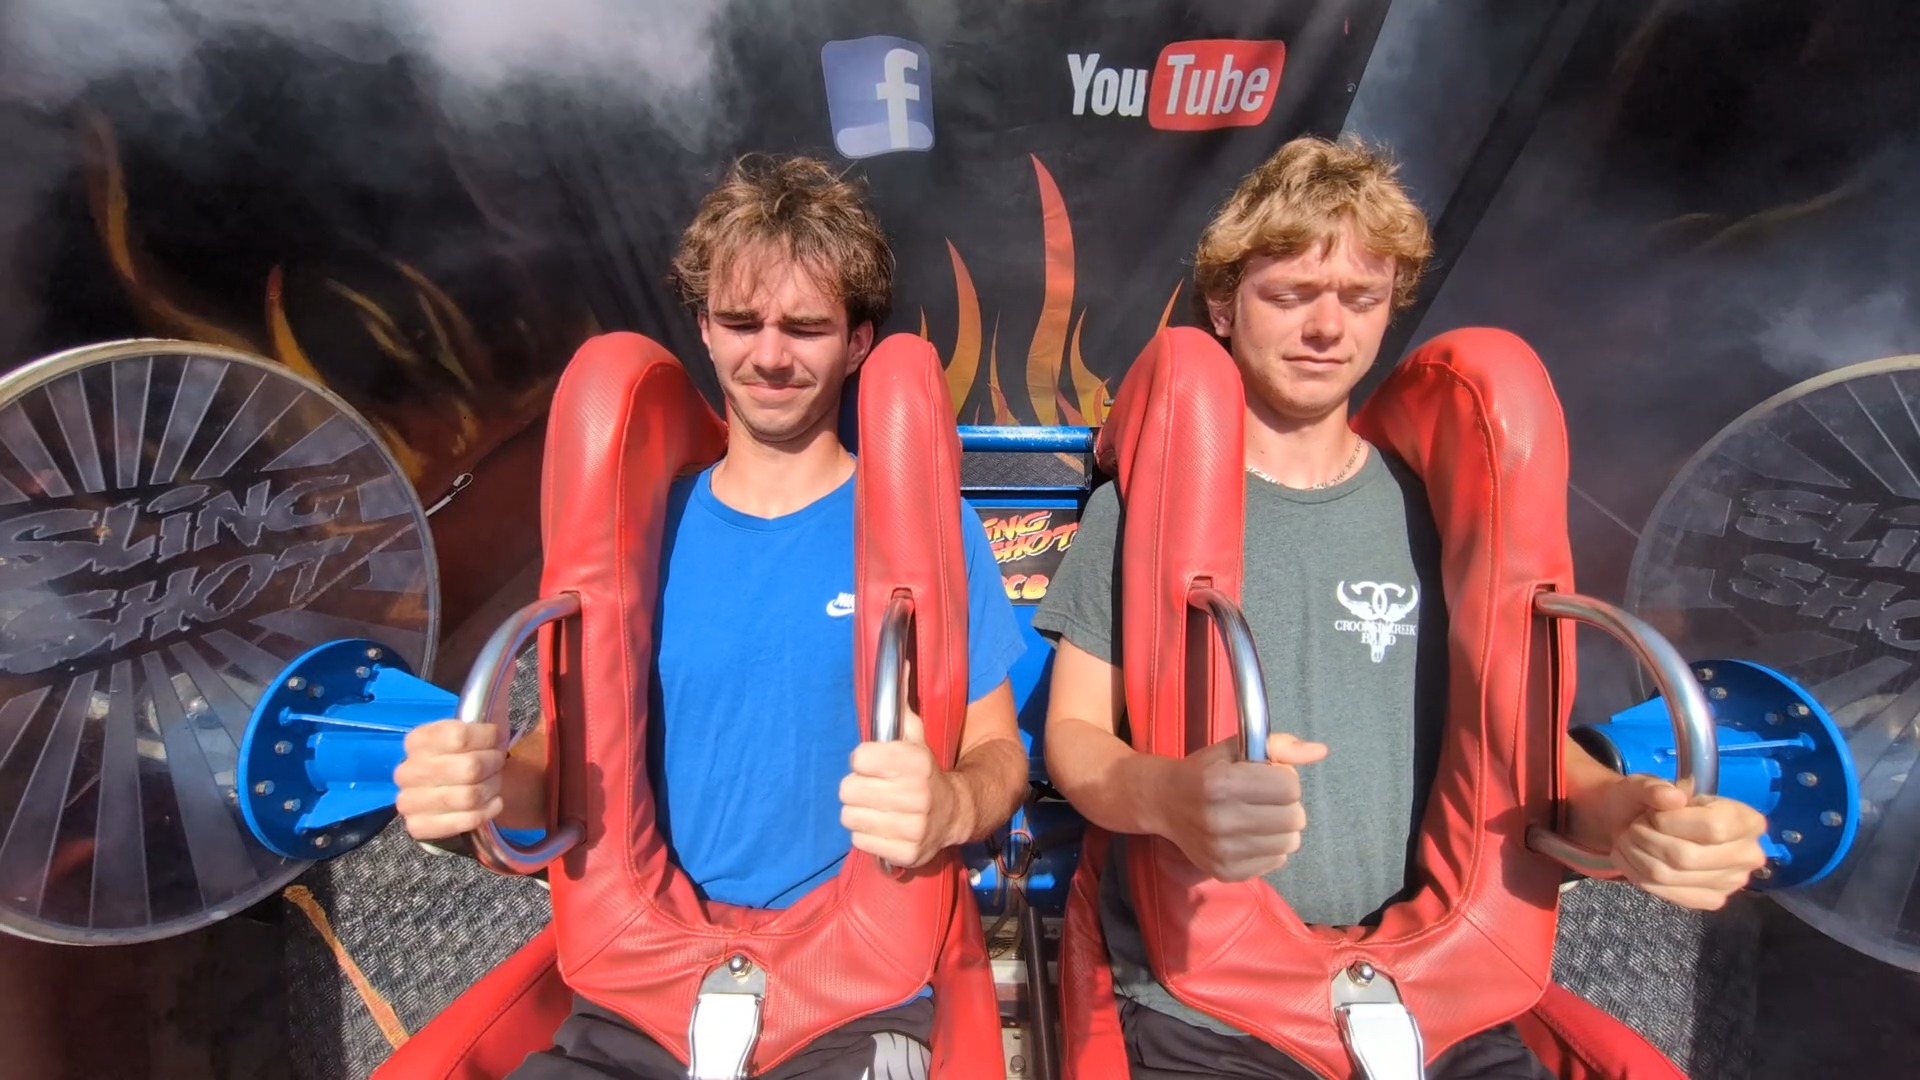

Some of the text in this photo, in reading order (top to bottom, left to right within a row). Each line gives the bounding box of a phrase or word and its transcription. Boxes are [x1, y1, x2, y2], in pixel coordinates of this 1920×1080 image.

[876, 48, 919, 148] f
[1067, 53, 1270, 116] YouTube
[1002, 574, 1050, 600] CB
